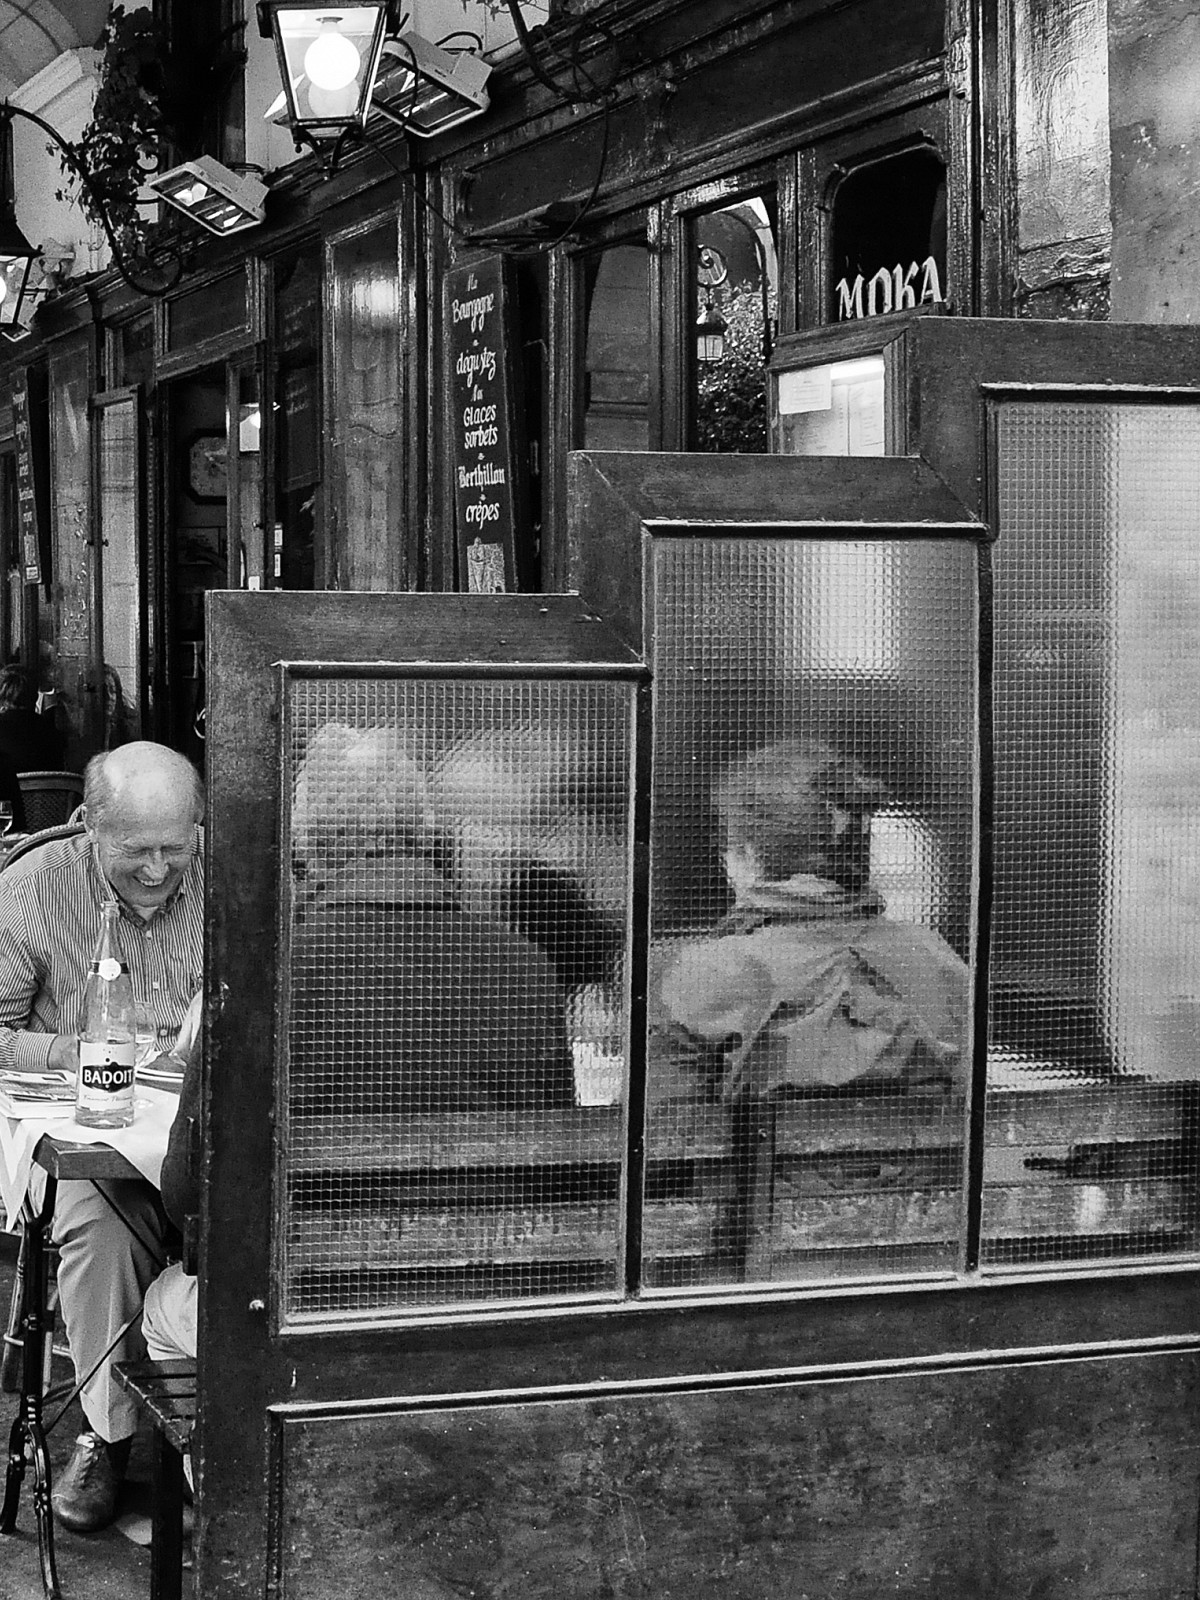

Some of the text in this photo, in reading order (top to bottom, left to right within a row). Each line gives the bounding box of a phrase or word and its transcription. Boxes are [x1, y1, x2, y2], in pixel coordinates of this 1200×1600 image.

[835, 256, 942, 320] MOKA
[463, 404, 497, 427] Glaces
[464, 424, 498, 449] sorbets
[457, 462, 505, 492] Berthillon
[84, 1069, 133, 1085] BADOIT
